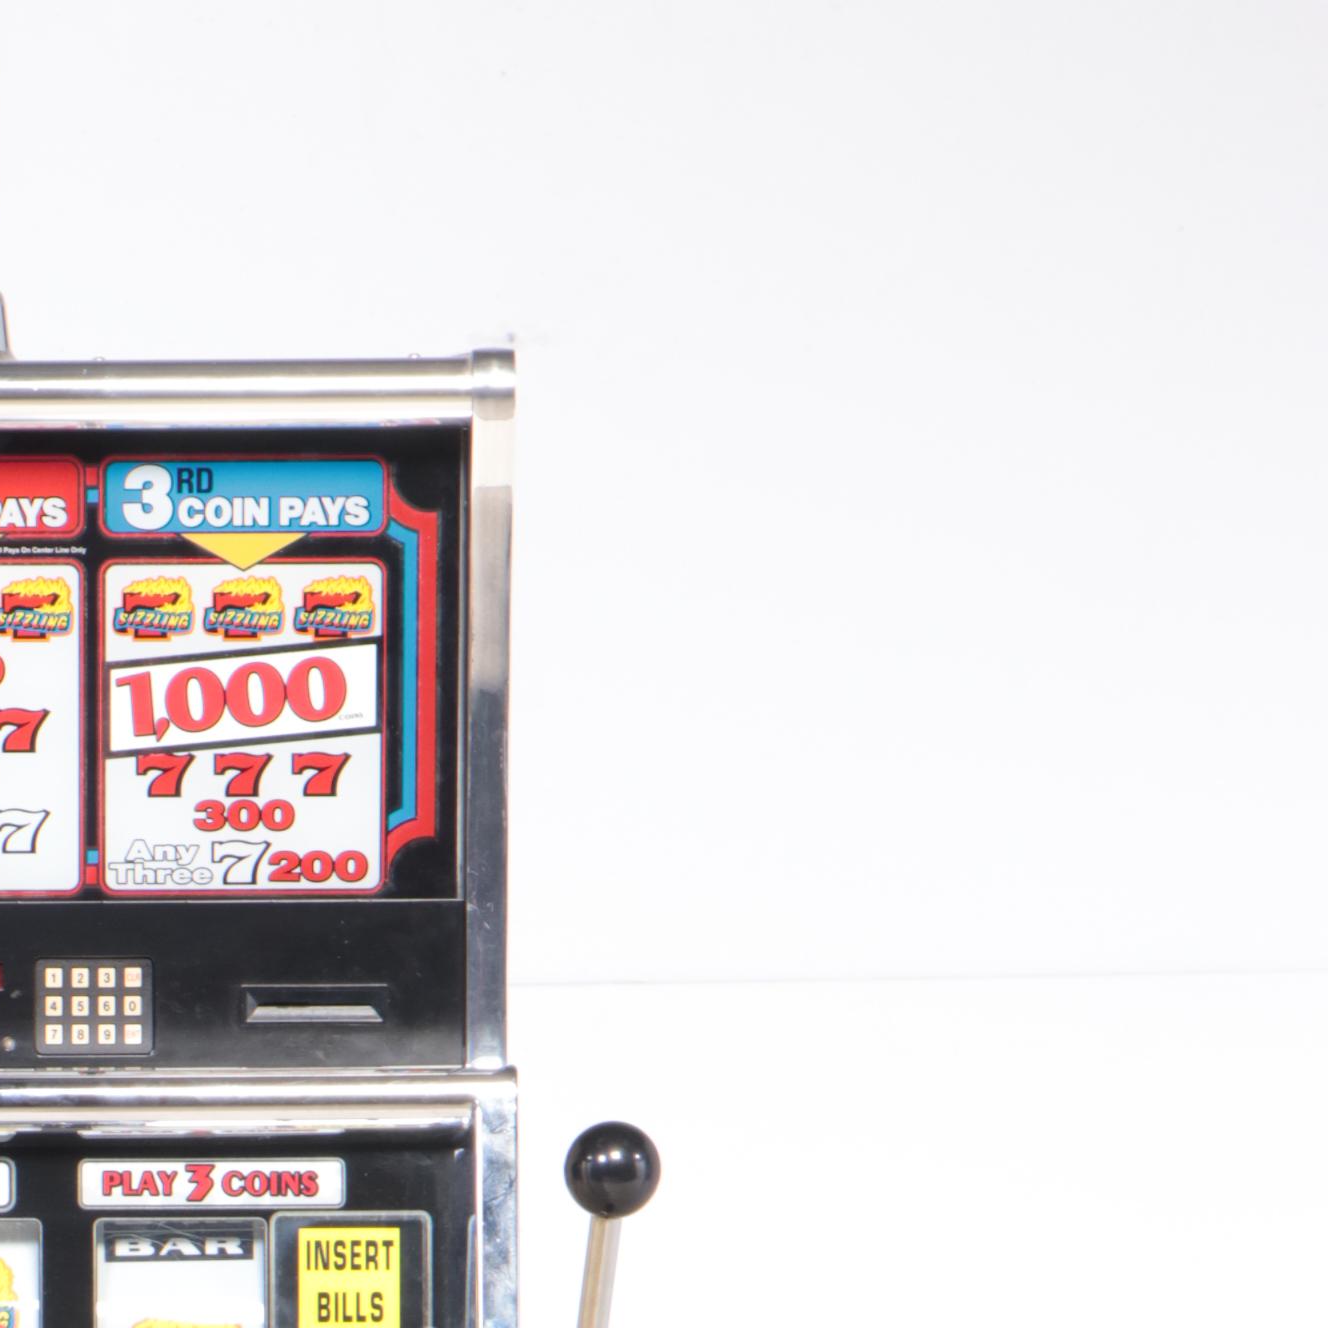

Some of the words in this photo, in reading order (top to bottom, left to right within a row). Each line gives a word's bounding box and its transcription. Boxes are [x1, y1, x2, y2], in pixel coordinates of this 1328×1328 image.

[177, 496, 270, 528] COIN
[279, 495, 371, 527] PAYS
[118, 608, 189, 630] SIZZLING
[208, 608, 280, 630] SIZZLING
[298, 608, 370, 630] SIZZLING
[115, 656, 347, 742] 1,000
[136, 752, 196, 797] 7
[214, 752, 274, 797] 7
[291, 752, 352, 797] 7
[193, 799, 295, 832] 300
[108, 859, 213, 885] Three
[211, 840, 272, 885] 7
[124, 839, 200, 866] Any
[268, 850, 369, 883] 200
[102, 1170, 177, 1196] PLAY
[185, 1164, 215, 1202] 3
[220, 1170, 319, 1196] COINS
[114, 1237, 244, 1257] BAR
[306, 1240, 394, 1271] INSERT
[317, 1292, 384, 1323] BILLS
